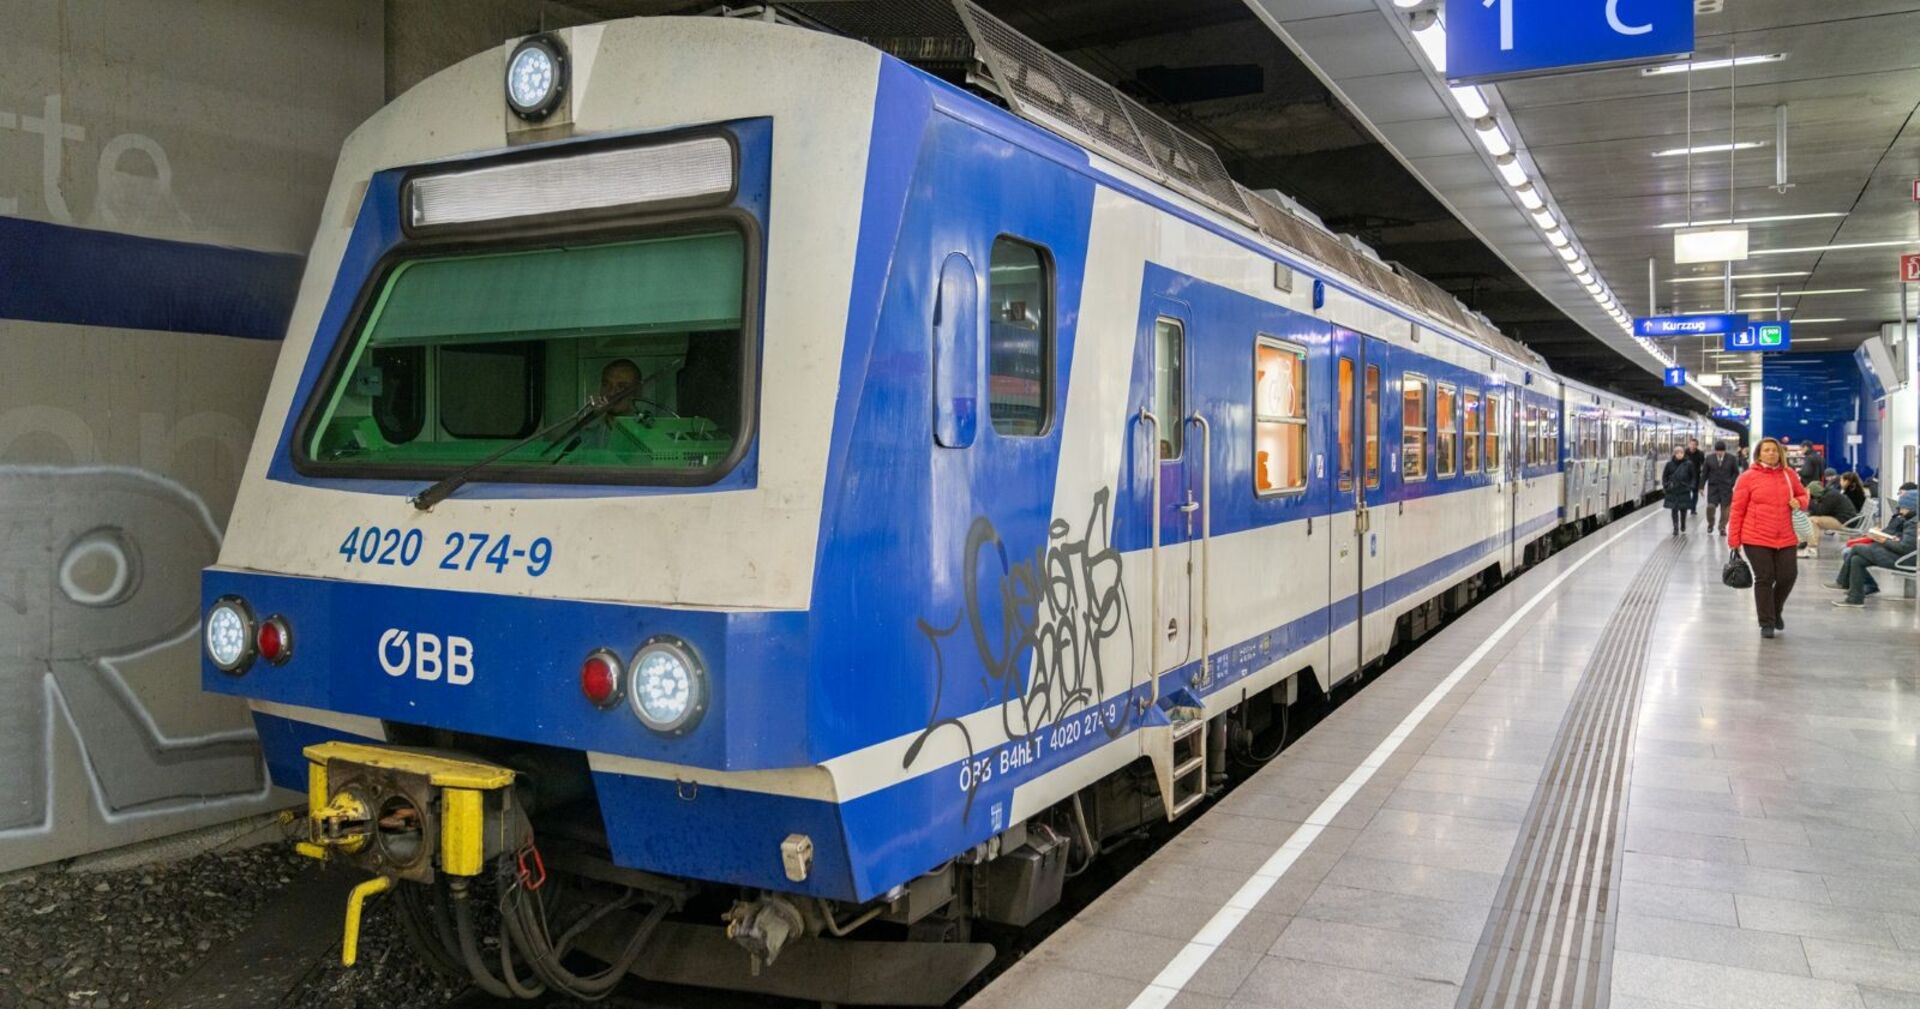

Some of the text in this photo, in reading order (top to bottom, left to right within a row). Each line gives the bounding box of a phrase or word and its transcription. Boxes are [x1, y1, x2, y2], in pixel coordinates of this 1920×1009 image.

[1662, 320, 1706, 332] Kurzzug
[1670, 369, 1680, 384] 1
[338, 526, 553, 577] 4020 274-9
[378, 627, 475, 686] ÖBB
[959, 757, 992, 792] ÖBB
[1050, 719, 1081, 750] 4020
